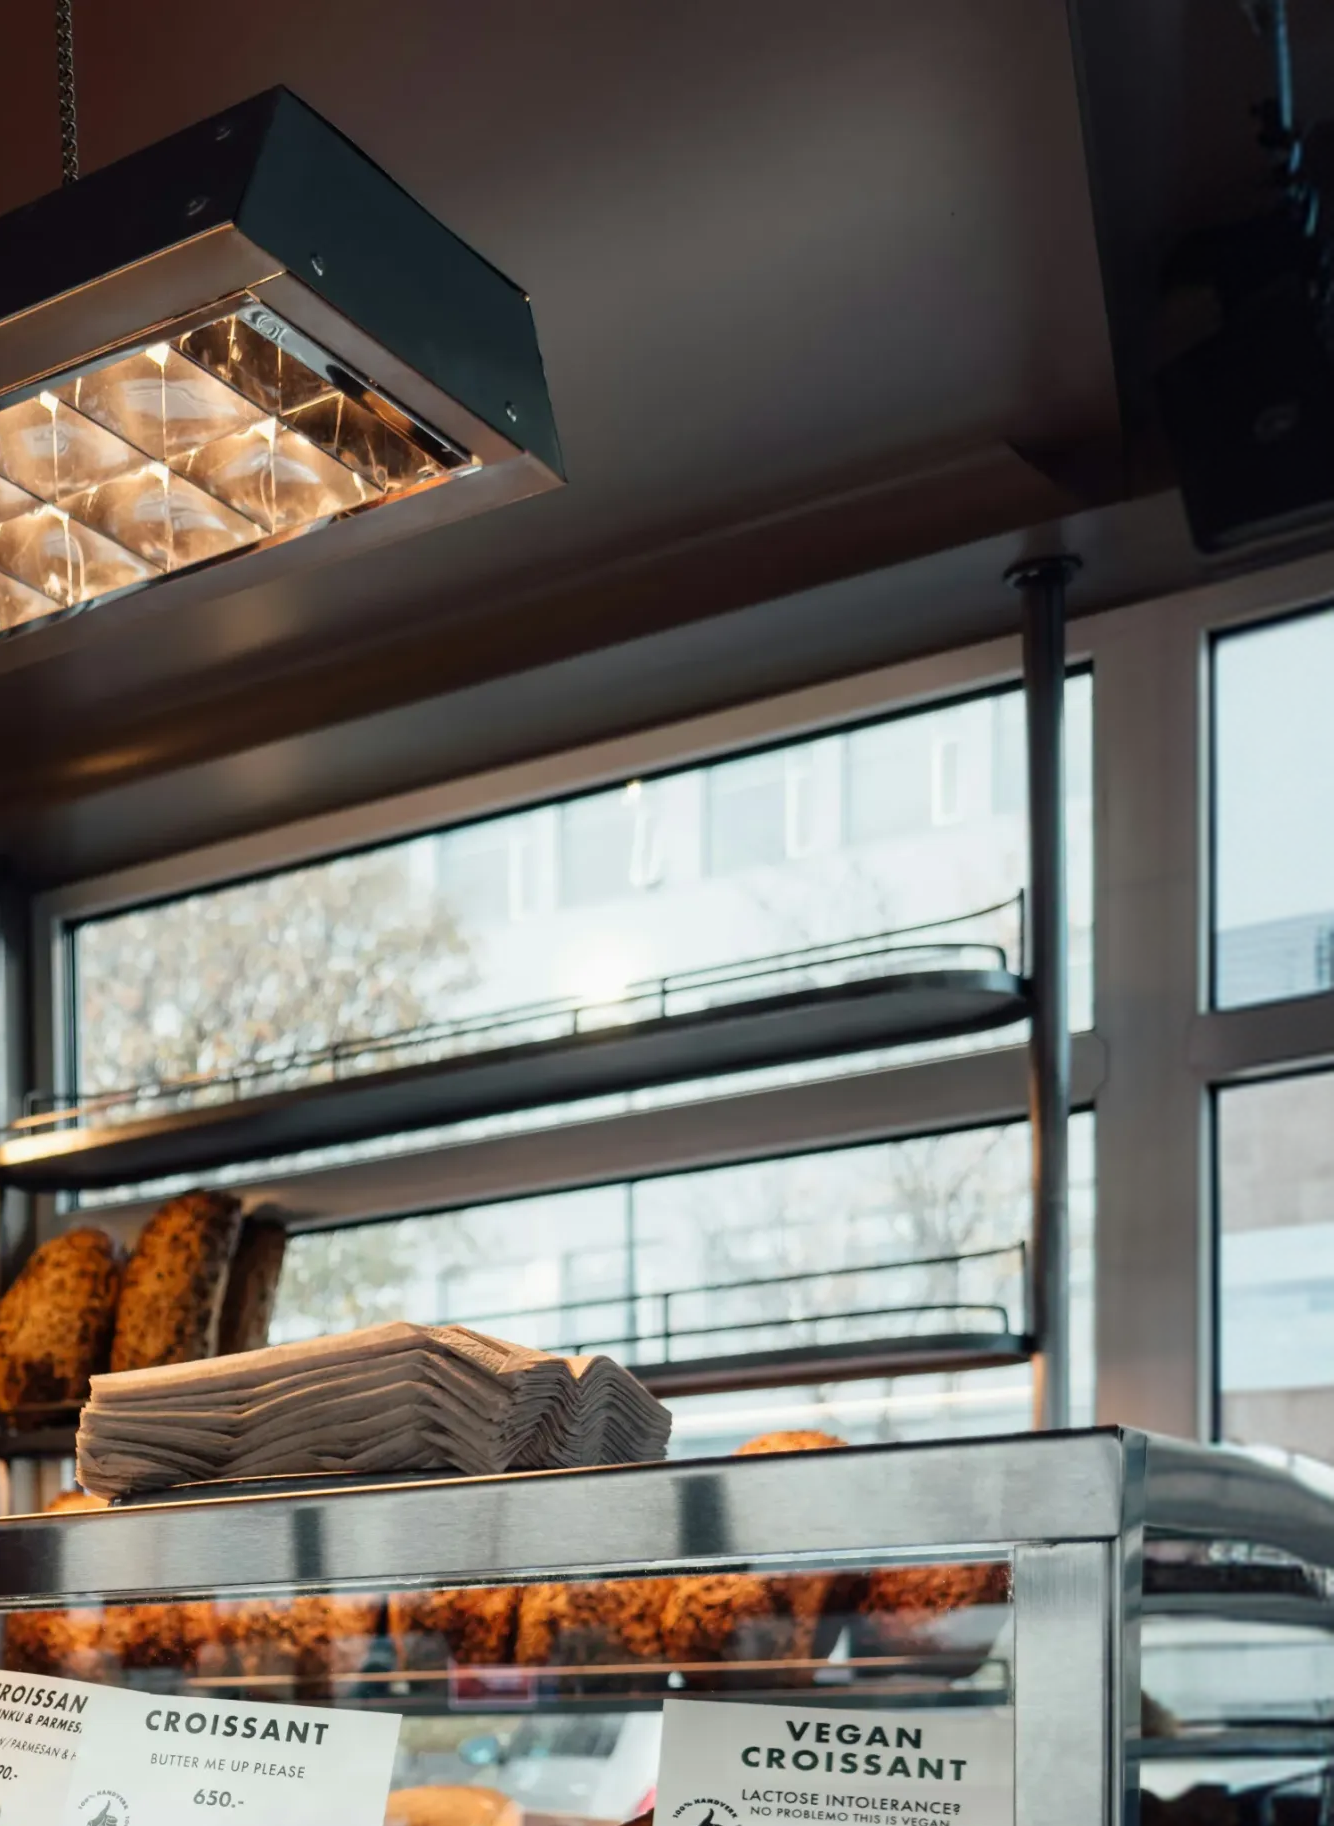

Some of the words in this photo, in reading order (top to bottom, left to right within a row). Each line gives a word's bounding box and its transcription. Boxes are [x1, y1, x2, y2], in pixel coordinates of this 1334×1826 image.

[24, 1713, 34, 1725] &
[35, 1714, 83, 1735] PARMES
[145, 1710, 330, 1745] CROISSANT
[785, 1720, 922, 1750] VEGAN
[61, 1748, 69, 1761] &
[150, 1752, 199, 1768] BUTTER
[204, 1758, 226, 1771] ME
[230, 1760, 250, 1773] UP
[253, 1762, 306, 1779] PLEASE
[741, 1746, 967, 1781] CROISSANT
[193, 1788, 244, 1809] 650.-
[741, 1788, 819, 1806] LACTOSE
[825, 1794, 961, 1816] INTOLERANCE?
[750, 1806, 772, 1817] NO
[776, 1807, 849, 1822] PROBLEMO
[852, 1813, 881, 1825] THIS
[885, 1815, 898, 1826] IS
